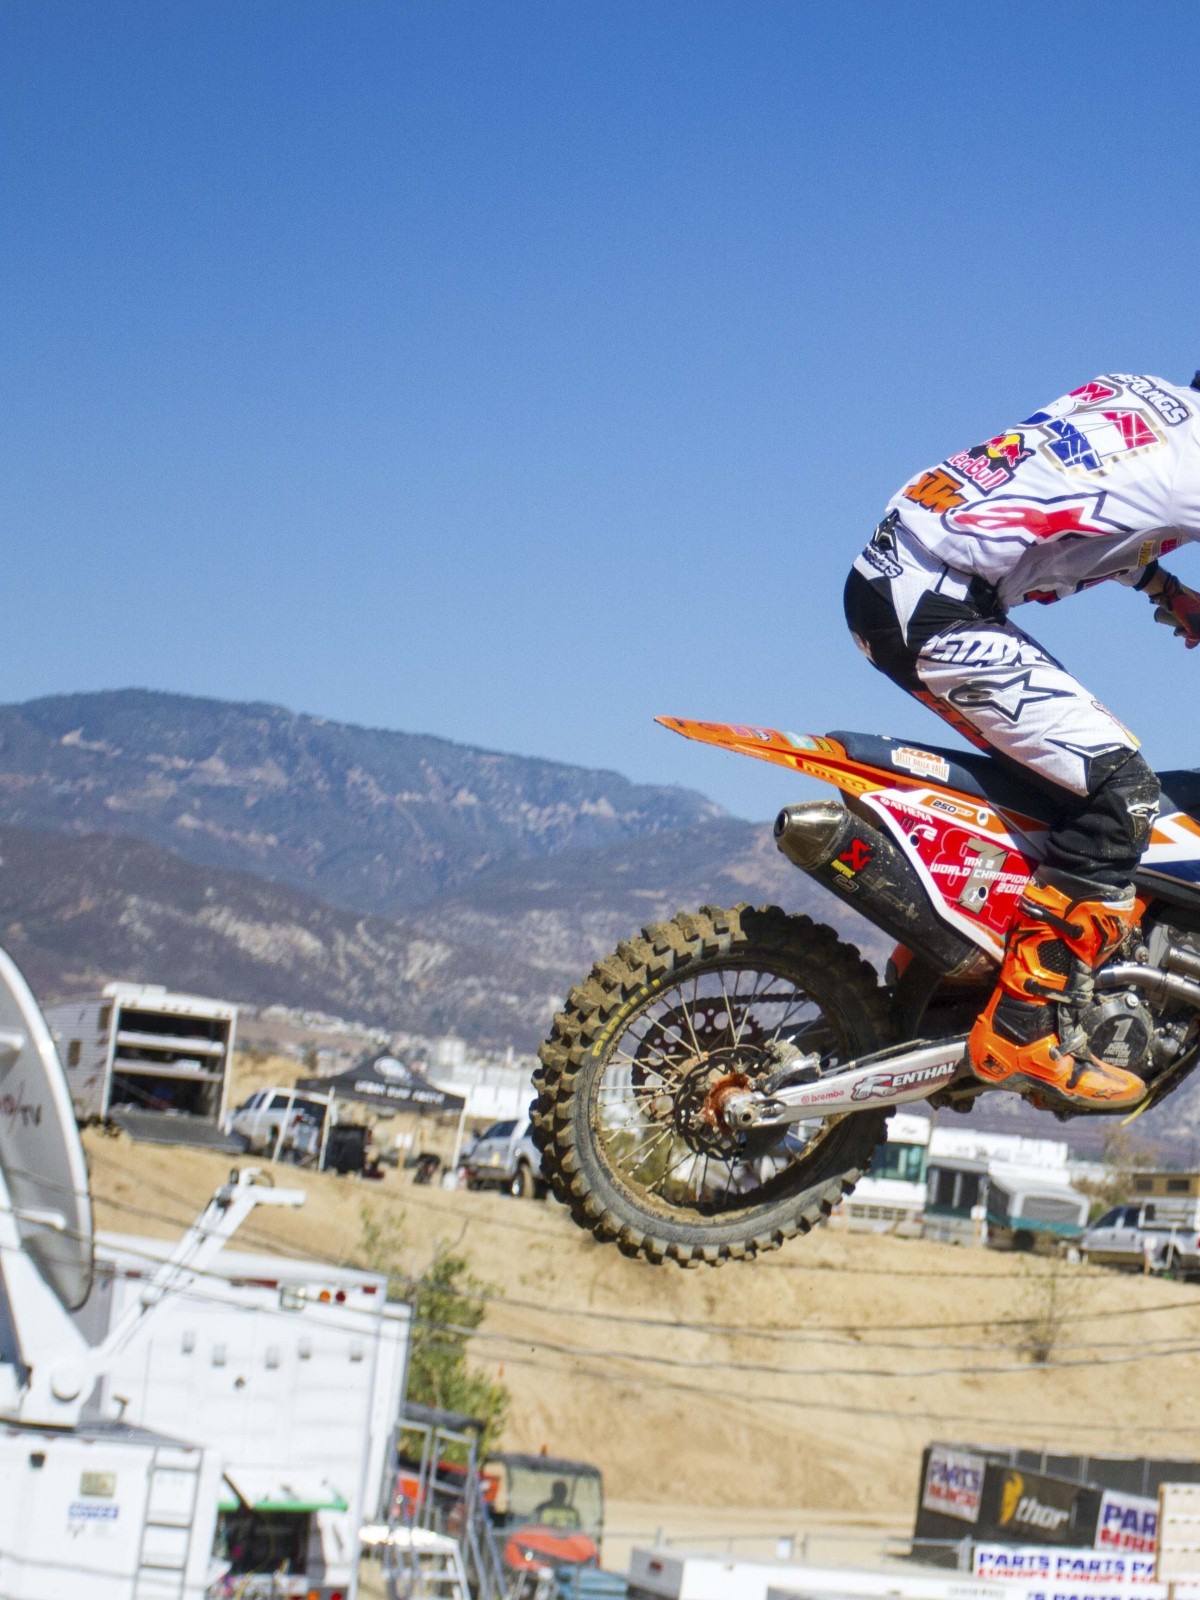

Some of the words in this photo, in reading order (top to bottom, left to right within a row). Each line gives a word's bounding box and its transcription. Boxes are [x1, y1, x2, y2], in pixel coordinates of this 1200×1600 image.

[890, 802, 934, 825] ATHENA
[933, 800, 957, 813] 250
[930, 862, 971, 877] WORLD
[964, 856, 983, 867] MX
[985, 859, 995, 869] 2
[996, 882, 1026, 895] 2016
[811, 1090, 845, 1102] brembo
[1014, 1496, 1069, 1531] thor
[1103, 1503, 1157, 1535] PAR
[979, 1553, 1050, 1569] PARTS
[1056, 1557, 1126, 1573] PARTS
